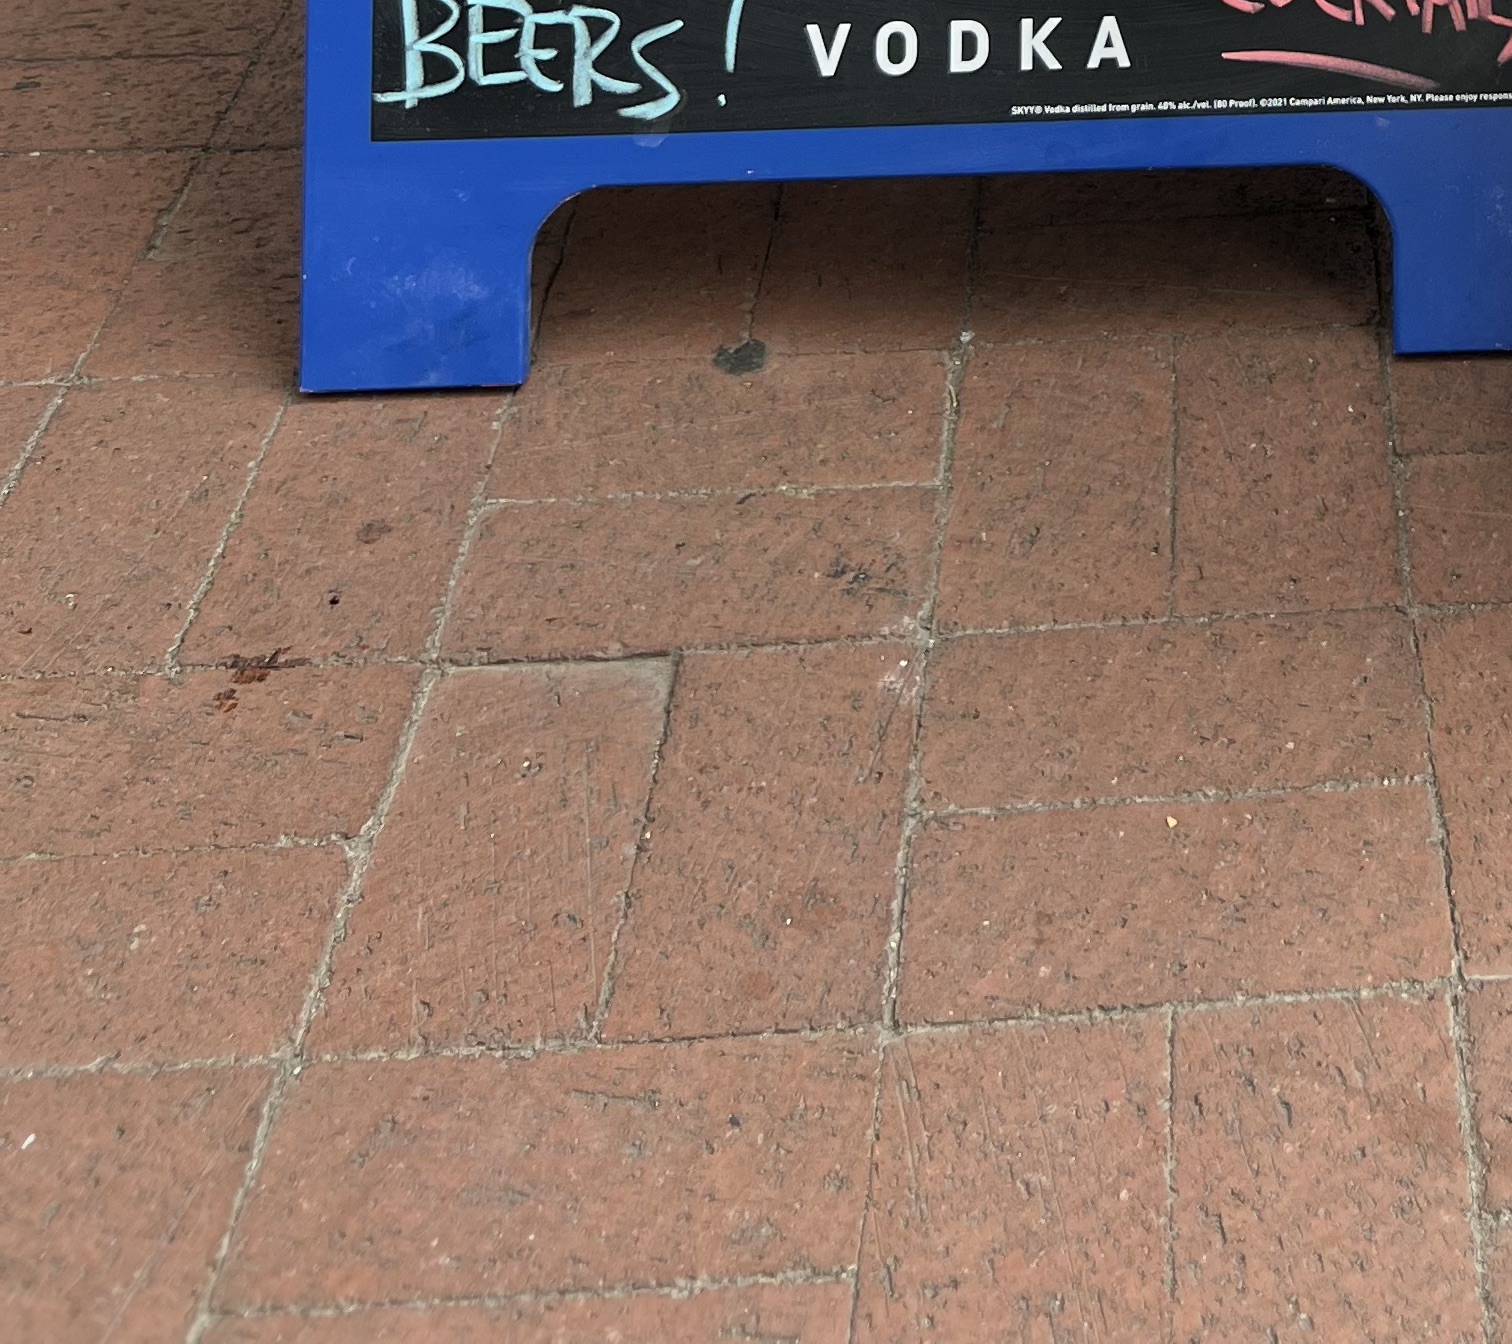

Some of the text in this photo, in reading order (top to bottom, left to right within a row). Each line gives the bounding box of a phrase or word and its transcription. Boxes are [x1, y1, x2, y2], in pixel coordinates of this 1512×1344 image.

[806, 14, 1132, 77] VODKA
[1044, 103, 1070, 114] Vodka
[1072, 102, 1107, 113] distilled
[1108, 102, 1130, 112] from
[1131, 102, 1157, 113] grain.
[1157, 101, 1176, 111] 40%
[1289, 95, 1326, 108] Campari
[1327, 95, 1365, 106] America,
[1366, 94, 1386, 104] New
[1386, 93, 1408, 104] York,
[1410, 93, 1424, 103] NY.
[1425, 92, 1454, 102] Please
[1455, 91, 1478, 103] enjoy
